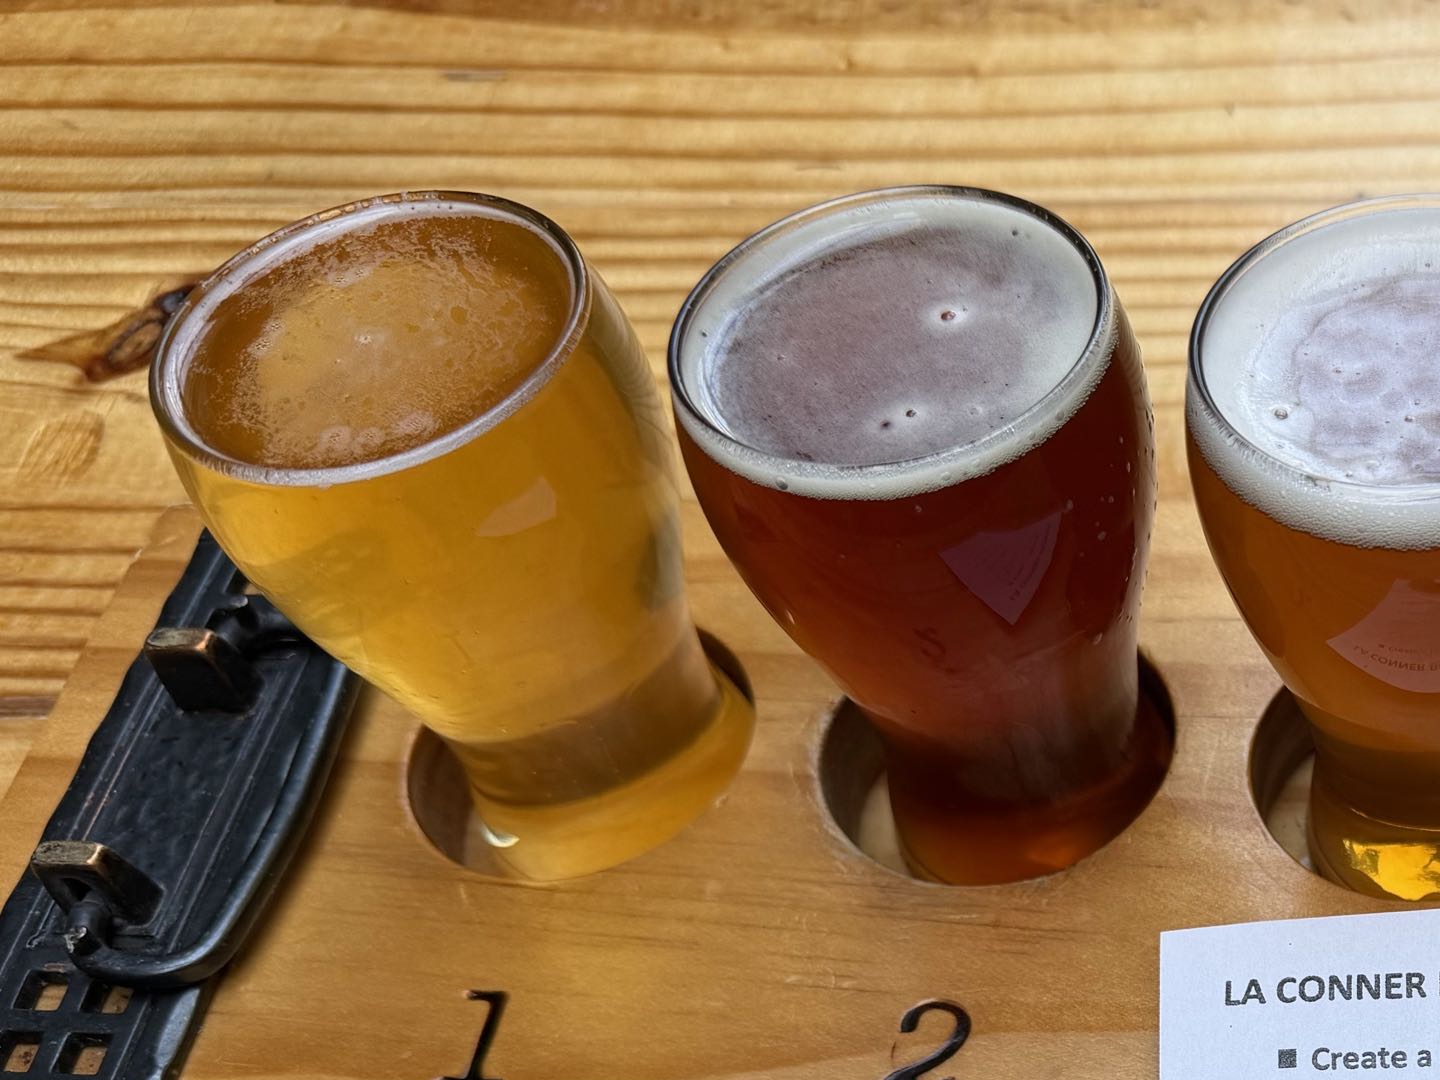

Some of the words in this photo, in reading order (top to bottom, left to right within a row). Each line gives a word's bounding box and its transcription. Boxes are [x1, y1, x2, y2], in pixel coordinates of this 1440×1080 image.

[1225, 978, 1267, 1006] LA
[1276, 972, 1427, 1004] CONNER
[1311, 1044, 1408, 1071] Create
[1417, 1048, 1432, 1067] a
